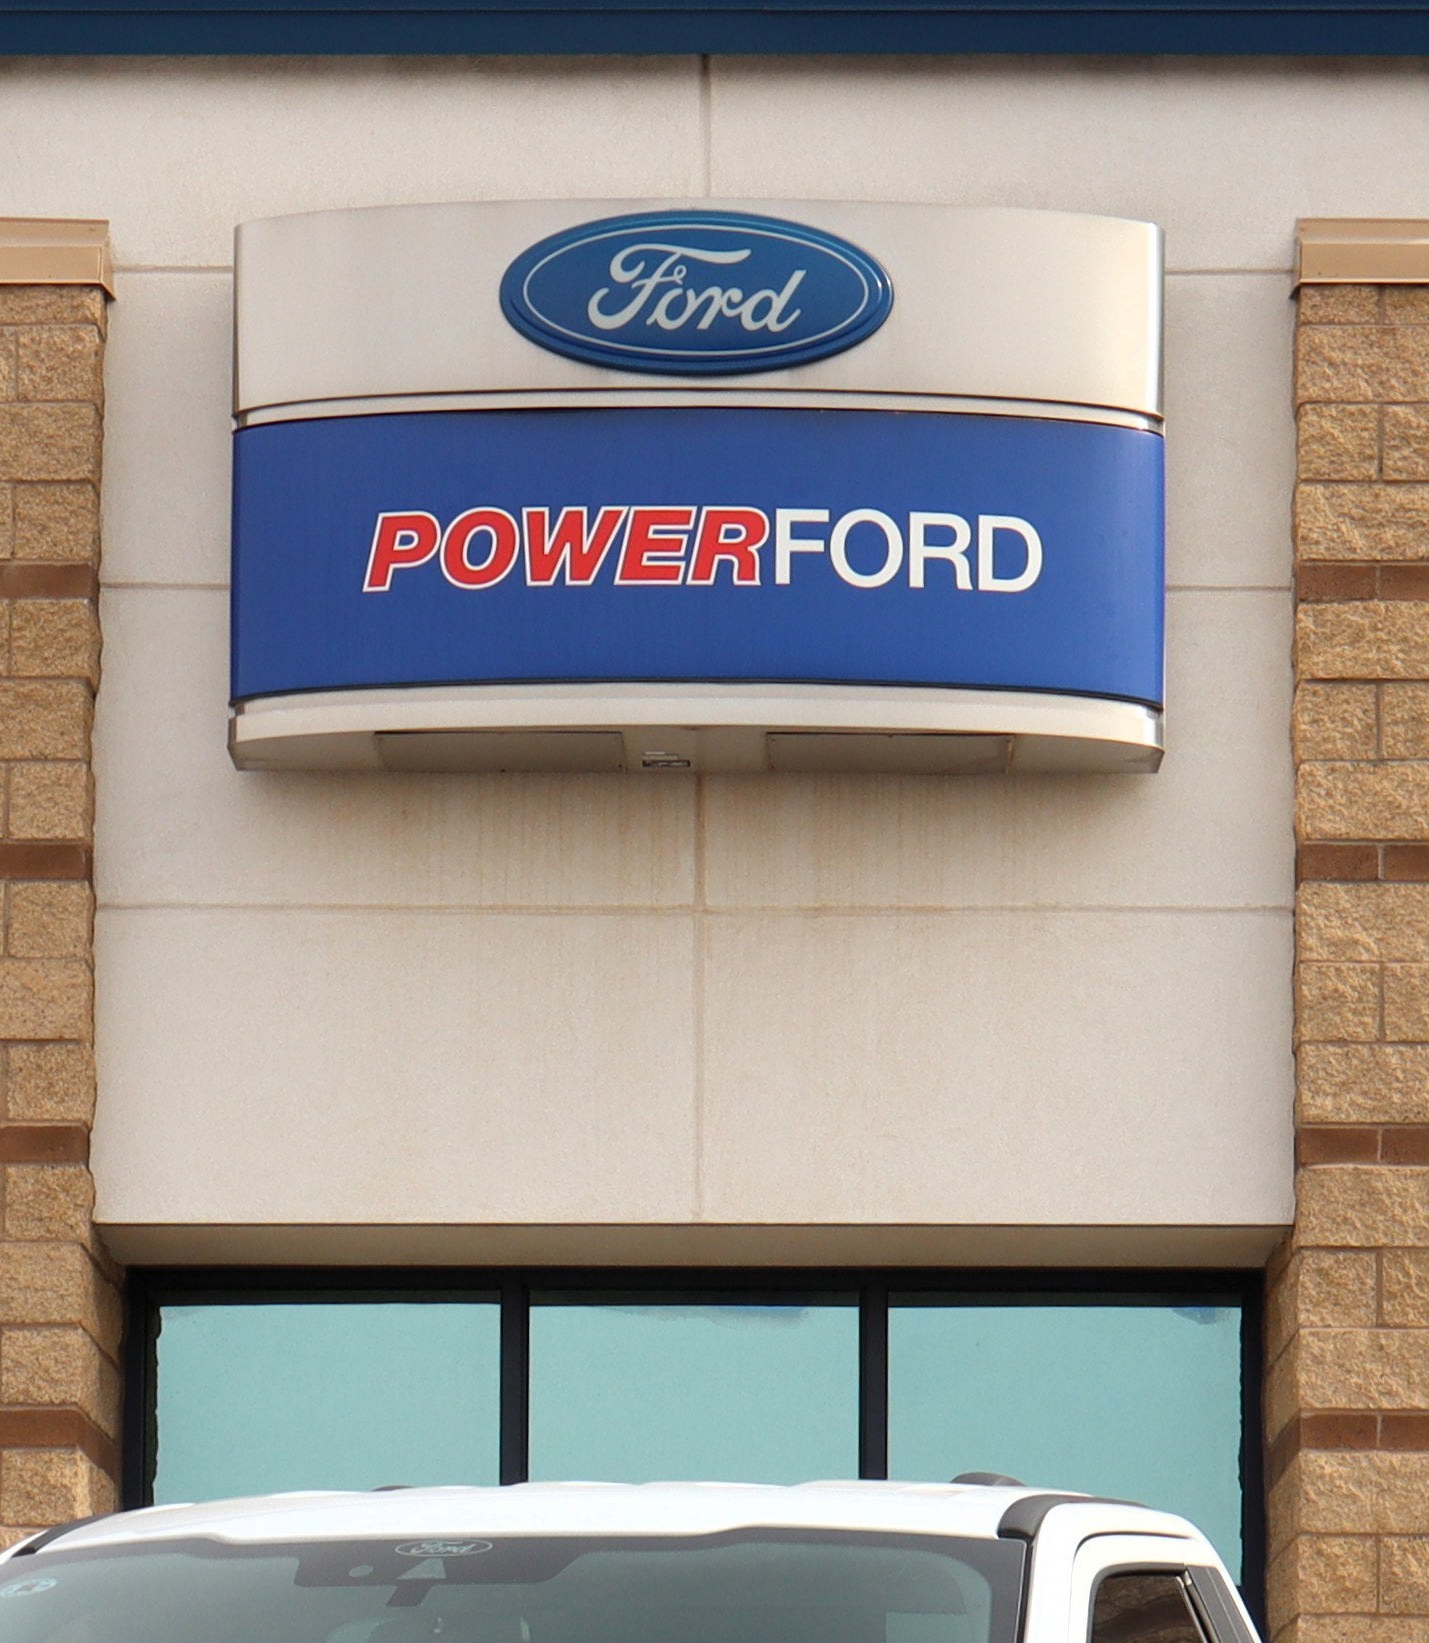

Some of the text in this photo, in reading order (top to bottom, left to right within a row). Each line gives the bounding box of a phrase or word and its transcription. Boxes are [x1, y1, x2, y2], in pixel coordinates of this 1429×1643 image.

[587, 242, 806, 338] Ford
[363, 506, 1043, 593] POWERFORD
[411, 1541, 476, 1554] Ford
